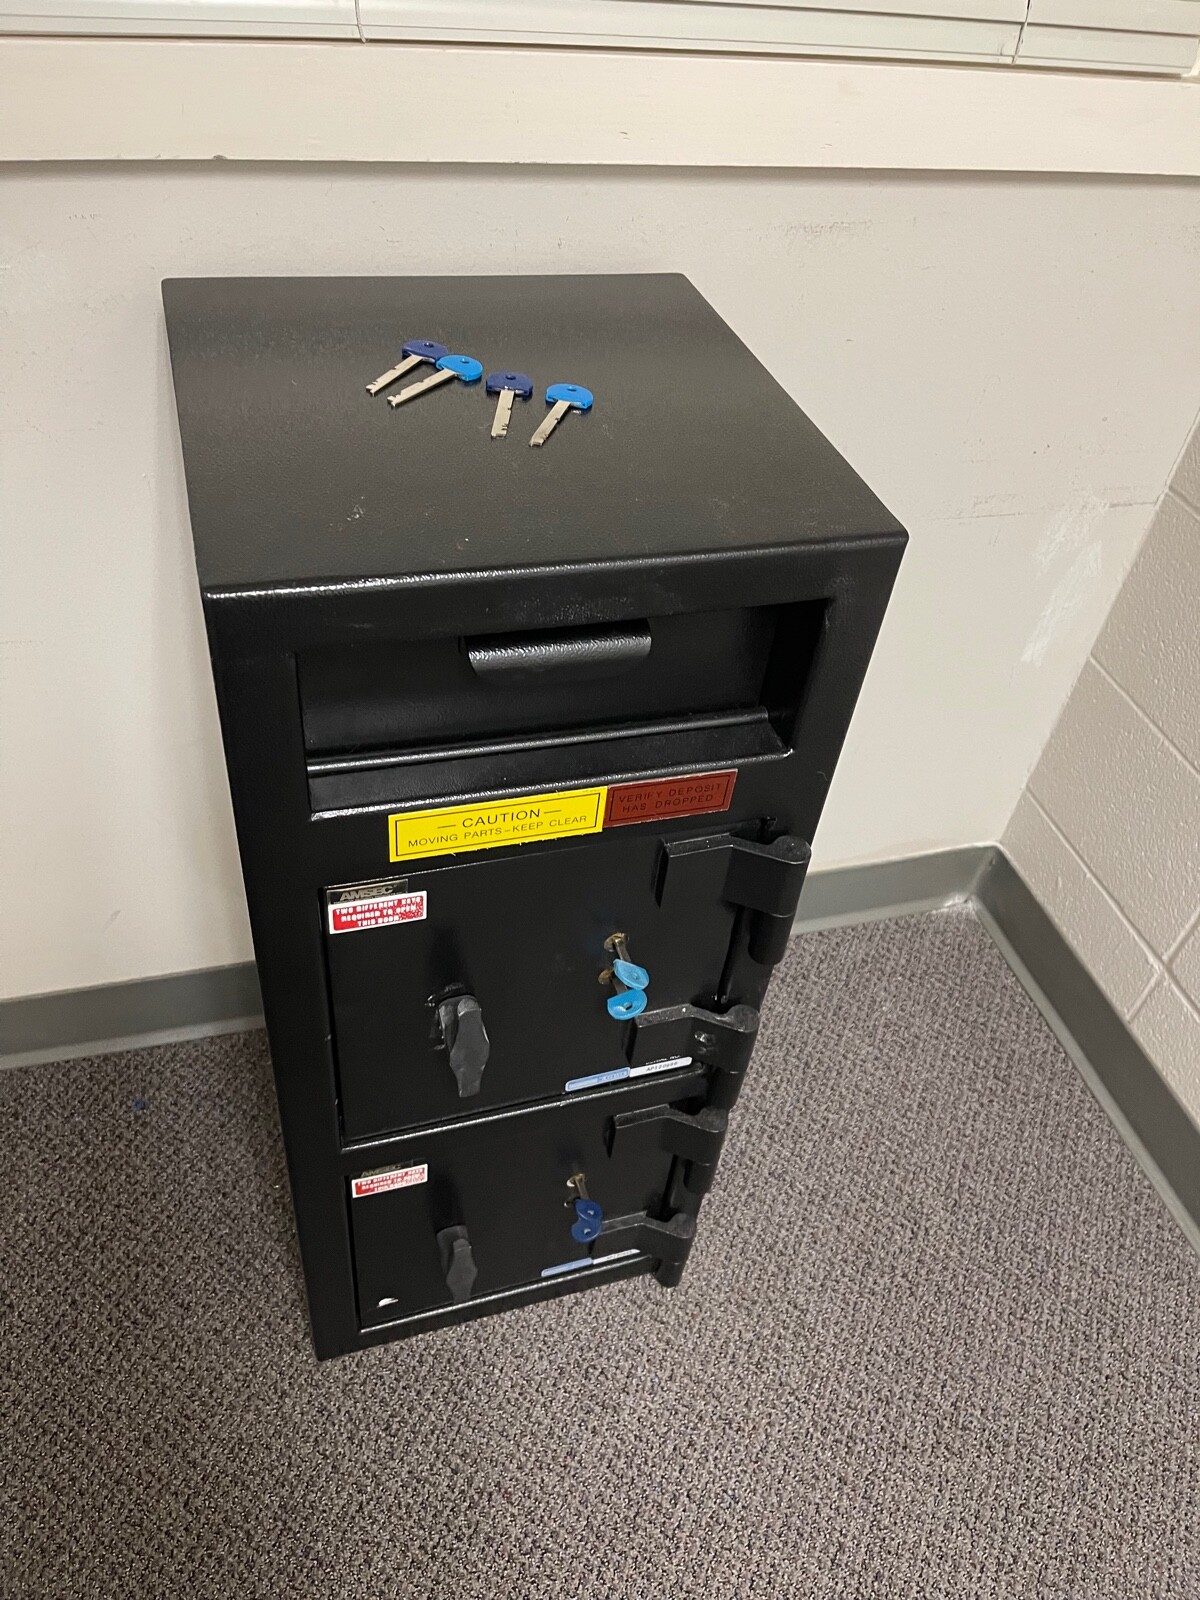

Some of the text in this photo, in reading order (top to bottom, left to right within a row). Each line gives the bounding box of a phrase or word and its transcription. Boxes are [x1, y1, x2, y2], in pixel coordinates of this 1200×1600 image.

[619, 783, 721, 803] VERIFY DEPOSIT
[622, 794, 714, 813] HAS DROPPED
[462, 808, 540, 828] CAUTION
[408, 833, 458, 848] MOVING
[549, 815, 587, 827] CLEAR
[340, 885, 394, 901] AMSEC
[335, 907, 354, 915] TWO
[356, 900, 399, 910] DIFFERENT
[401, 896, 421, 905] KEYS
[341, 911, 381, 922] REQUIRED
[383, 908, 393, 916] TO
[357, 918, 376, 927] THIS
